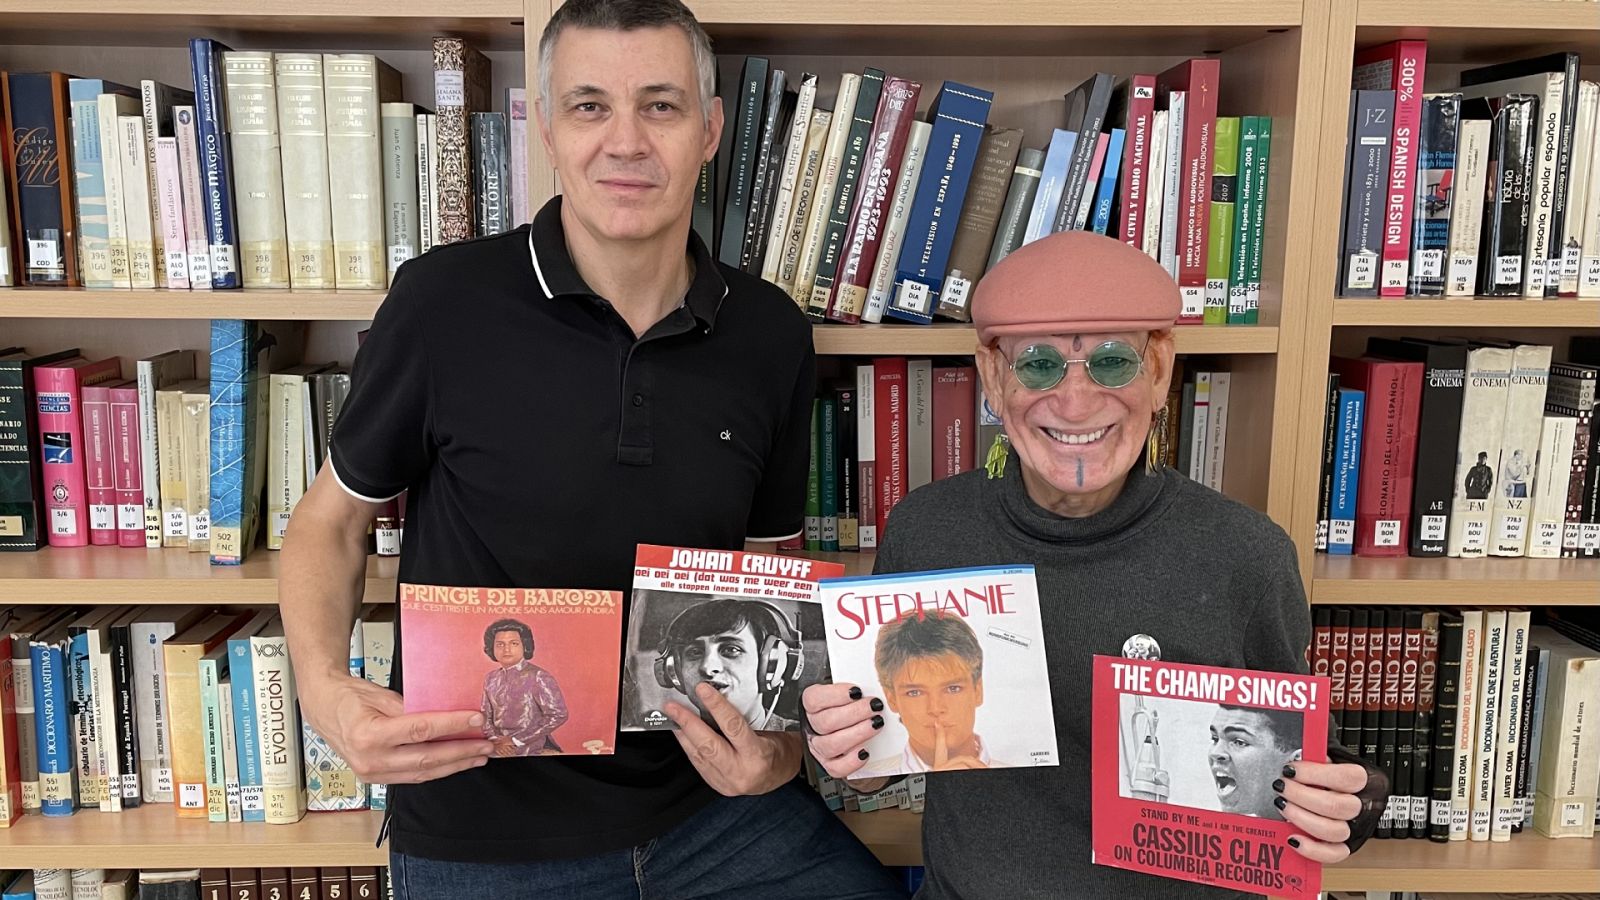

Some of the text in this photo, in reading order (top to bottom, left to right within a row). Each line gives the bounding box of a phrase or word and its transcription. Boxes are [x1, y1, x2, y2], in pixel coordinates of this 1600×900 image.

[1400, 58, 1415, 101] 300%
[143, 85, 156, 163] LOS MARGINADOS
[790, 129, 802, 142] de
[783, 144, 799, 175] estirpe
[1200, 123, 1208, 169] AUDIOVISUAL
[1540, 112, 1556, 207] popular española
[167, 178, 175, 217] fantásticos
[781, 177, 792, 192] La
[895, 145, 917, 218] 50 AÑOS DE TVE
[1127, 115, 1145, 237] CIVIL Y RADIO NACIONAL
[1190, 158, 1198, 203] AUDIOVISUAL
[1387, 127, 1409, 244] SPANISH DESIGN
[837, 184, 850, 213] CRONICA
[847, 131, 889, 274] LA RADIO EN ESPAÑA
[866, 168, 891, 240] 1923-1993
[921, 175, 950, 263] TELEVISION EN ESPAÑA
[1098, 199, 1109, 219] 2005
[1237, 146, 1252, 280] Televisión Informe 2008
[876, 253, 891, 291] LORENZO
[1208, 281, 1223, 290] 654
[1231, 288, 1246, 298] 654
[1206, 297, 1224, 306] PAN
[1231, 305, 1244, 313] TEL
[1430, 378, 1463, 388] CINEMA
[1473, 379, 1508, 389] CINEMA
[1512, 375, 1545, 386] CINEMA
[720, 429, 731, 441] ck
[890, 384, 899, 485] CONTEMPORÁNEOS MADRID
[1383, 377, 1398, 465] DEL CINE ESPAÑOL
[1340, 400, 1353, 491] ESPAÑOL NOVENTA
[218, 533, 232, 541] 502
[1585, 533, 1596, 541] CAP
[635, 568, 813, 591] oei oei oei (dat was me weer een
[669, 549, 813, 579] JOHAN CRUYFF
[444, 604, 470, 613] TRISTE
[473, 605, 487, 614] UN
[489, 606, 522, 614] MONDE
[524, 606, 547, 614] SANS
[488, 588, 516, 606] DE
[524, 589, 615, 608] BARODA
[679, 582, 710, 592] stoppen
[713, 584, 739, 593] ineens
[743, 585, 761, 594] naar
[764, 587, 774, 595] de
[777, 589, 811, 600] knoppen
[835, 584, 1016, 640] STEPHANIE
[253, 643, 284, 657] VOX
[1315, 631, 1330, 655] EL
[1111, 663, 1316, 710] THE CHAMP SINGS!
[1328, 632, 1348, 703] EL CINE
[1348, 633, 1365, 705] EL CINE
[1366, 632, 1383, 704] EL CINE
[1384, 633, 1401, 705] EL CINE
[1401, 633, 1420, 705] EL CINE
[1418, 632, 1437, 705] EL CINE
[1508, 628, 1523, 743] DICCIONARIO DEL CINE NEGRO
[1460, 659, 1473, 749] DICCIONARIO WESTERN
[1483, 627, 1500, 752] DICCIONARIO DEL CINE DE AVENTURAS
[44, 699, 56, 754] DICCIONARIO
[261, 703, 270, 765] DICCIONARIO
[268, 670, 286, 764] EVOLUCIÓN
[1457, 754, 1467, 797] JAVIER COMA
[1480, 758, 1490, 801] JAVIER COMA
[1503, 750, 1513, 798] JAVIER COMA
[1141, 808, 1168, 821] STAND
[1172, 813, 1183, 824] BY
[1187, 815, 1200, 827] ME
[1220, 823, 1229, 831] AM
[1246, 827, 1276, 838] GREATEST
[1114, 844, 1284, 890] ON COLUMBIA RECORDS
[1132, 823, 1285, 871] CASSIUS CLAY
[239, 889, 250, 900] 2
[270, 887, 281, 900] 3
[300, 886, 310, 900] 4
[330, 884, 340, 899] 5
[360, 883, 370, 898] 6
